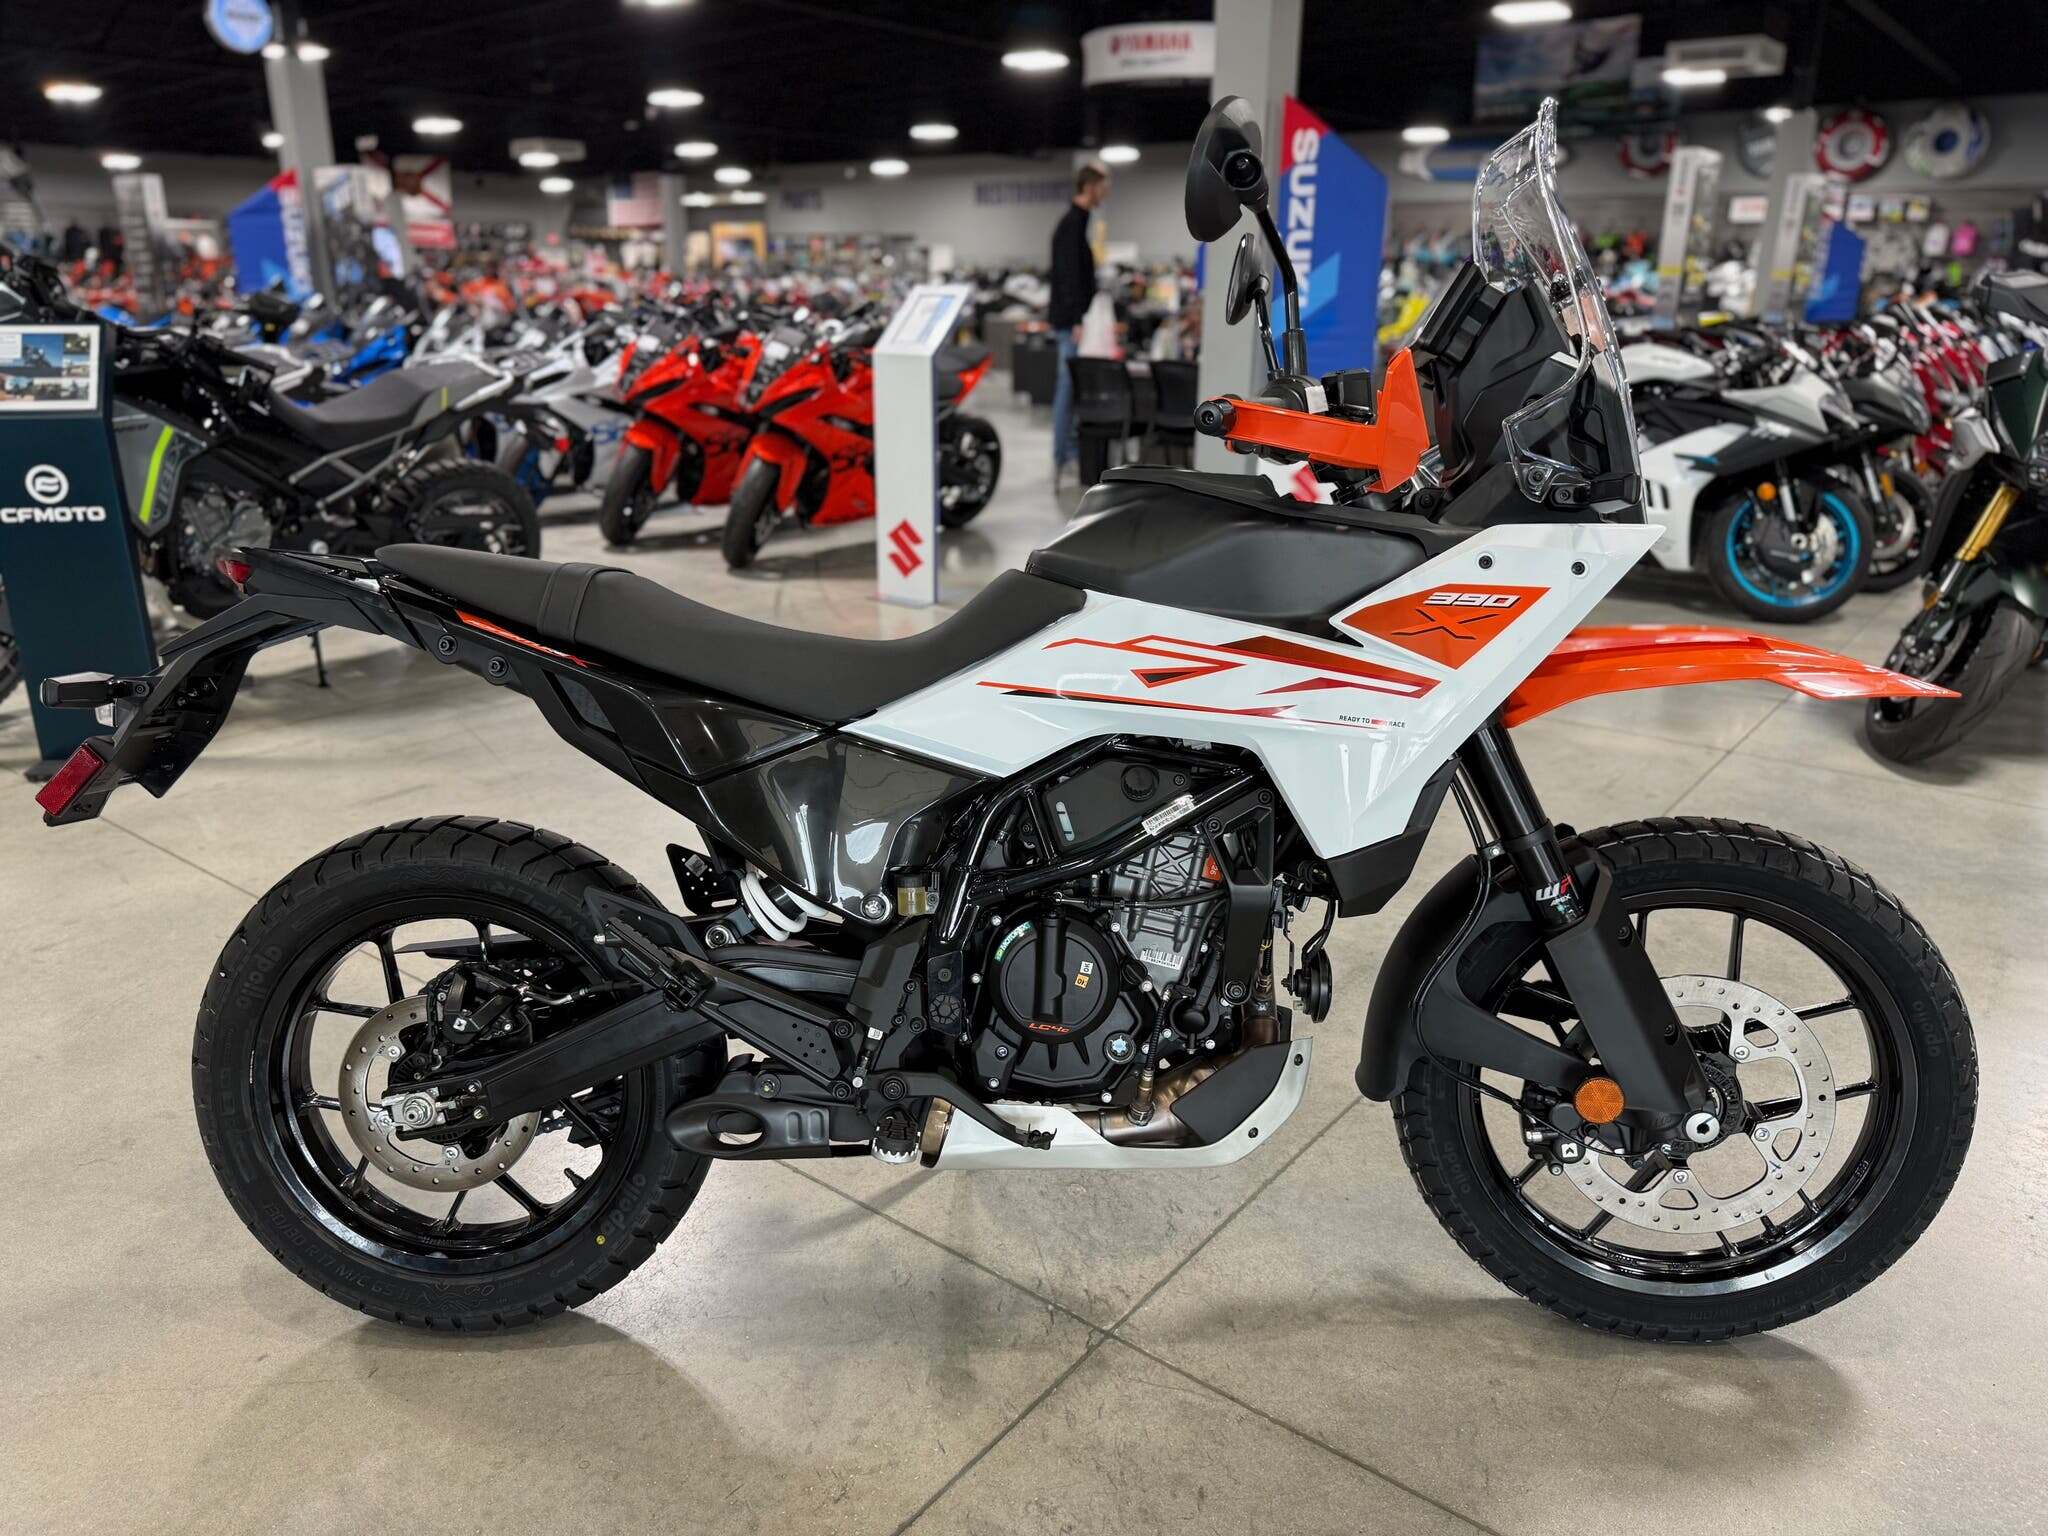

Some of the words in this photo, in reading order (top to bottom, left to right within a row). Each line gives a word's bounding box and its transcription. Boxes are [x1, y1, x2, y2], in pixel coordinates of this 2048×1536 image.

[0, 506, 106, 523] CFMOTO
[1422, 592, 1521, 608] 390
[1391, 606, 1500, 640] X
